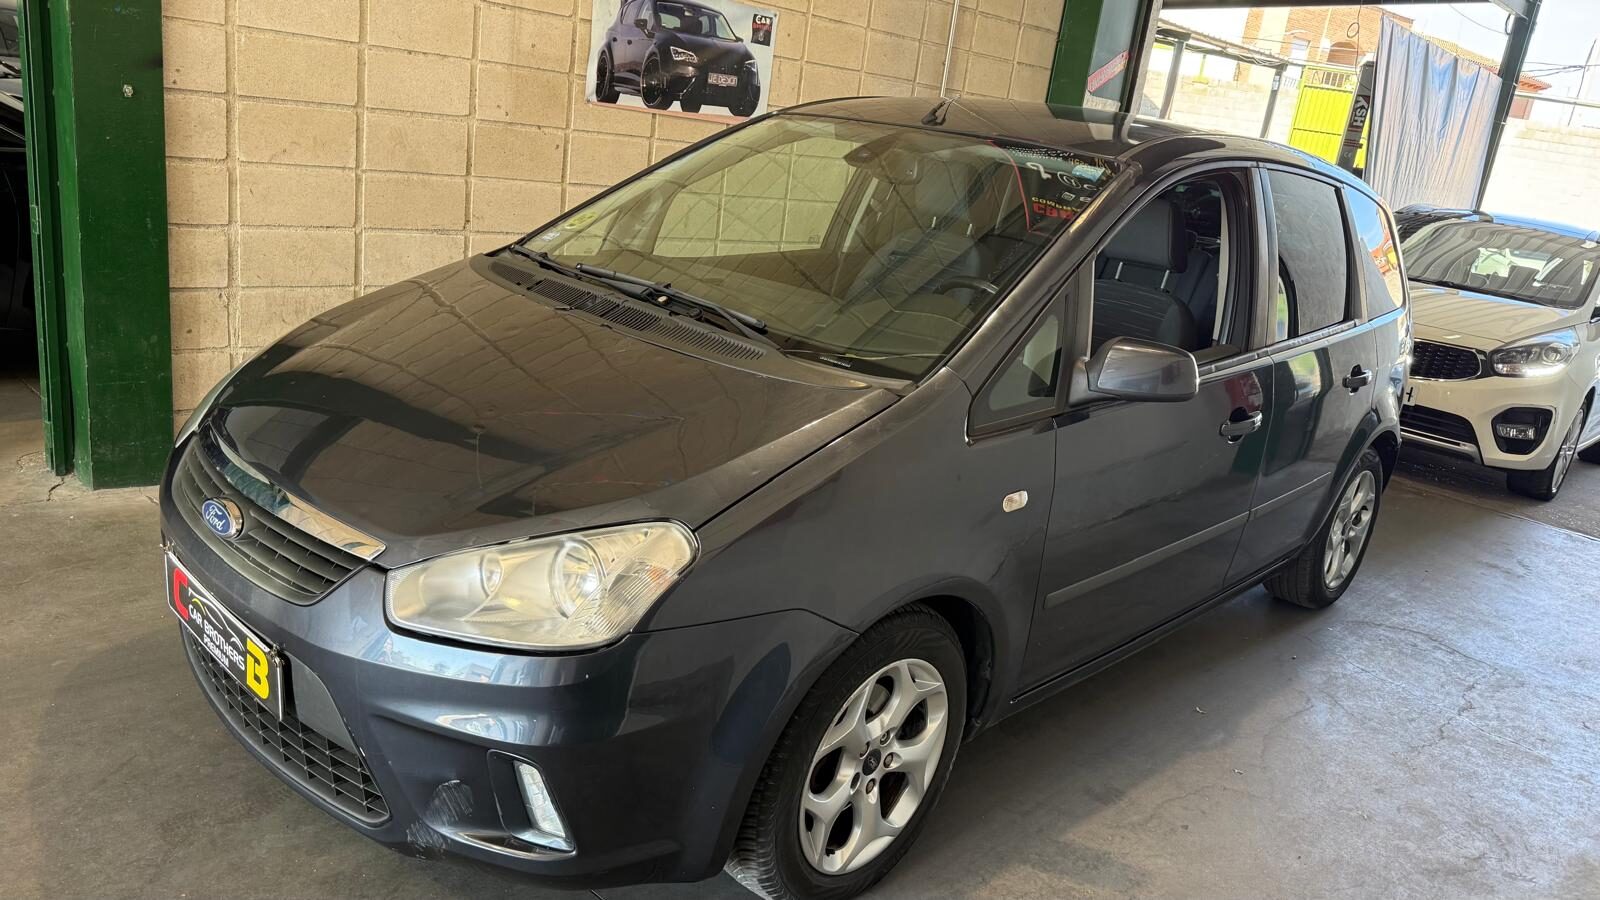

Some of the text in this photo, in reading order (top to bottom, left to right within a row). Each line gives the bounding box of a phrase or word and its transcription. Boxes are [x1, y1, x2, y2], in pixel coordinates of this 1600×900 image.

[206, 505, 226, 531] Ford
[189, 604, 245, 671] CAR BROTHERS
[203, 633, 229, 668] PREMIUM
[246, 637, 270, 700] B
